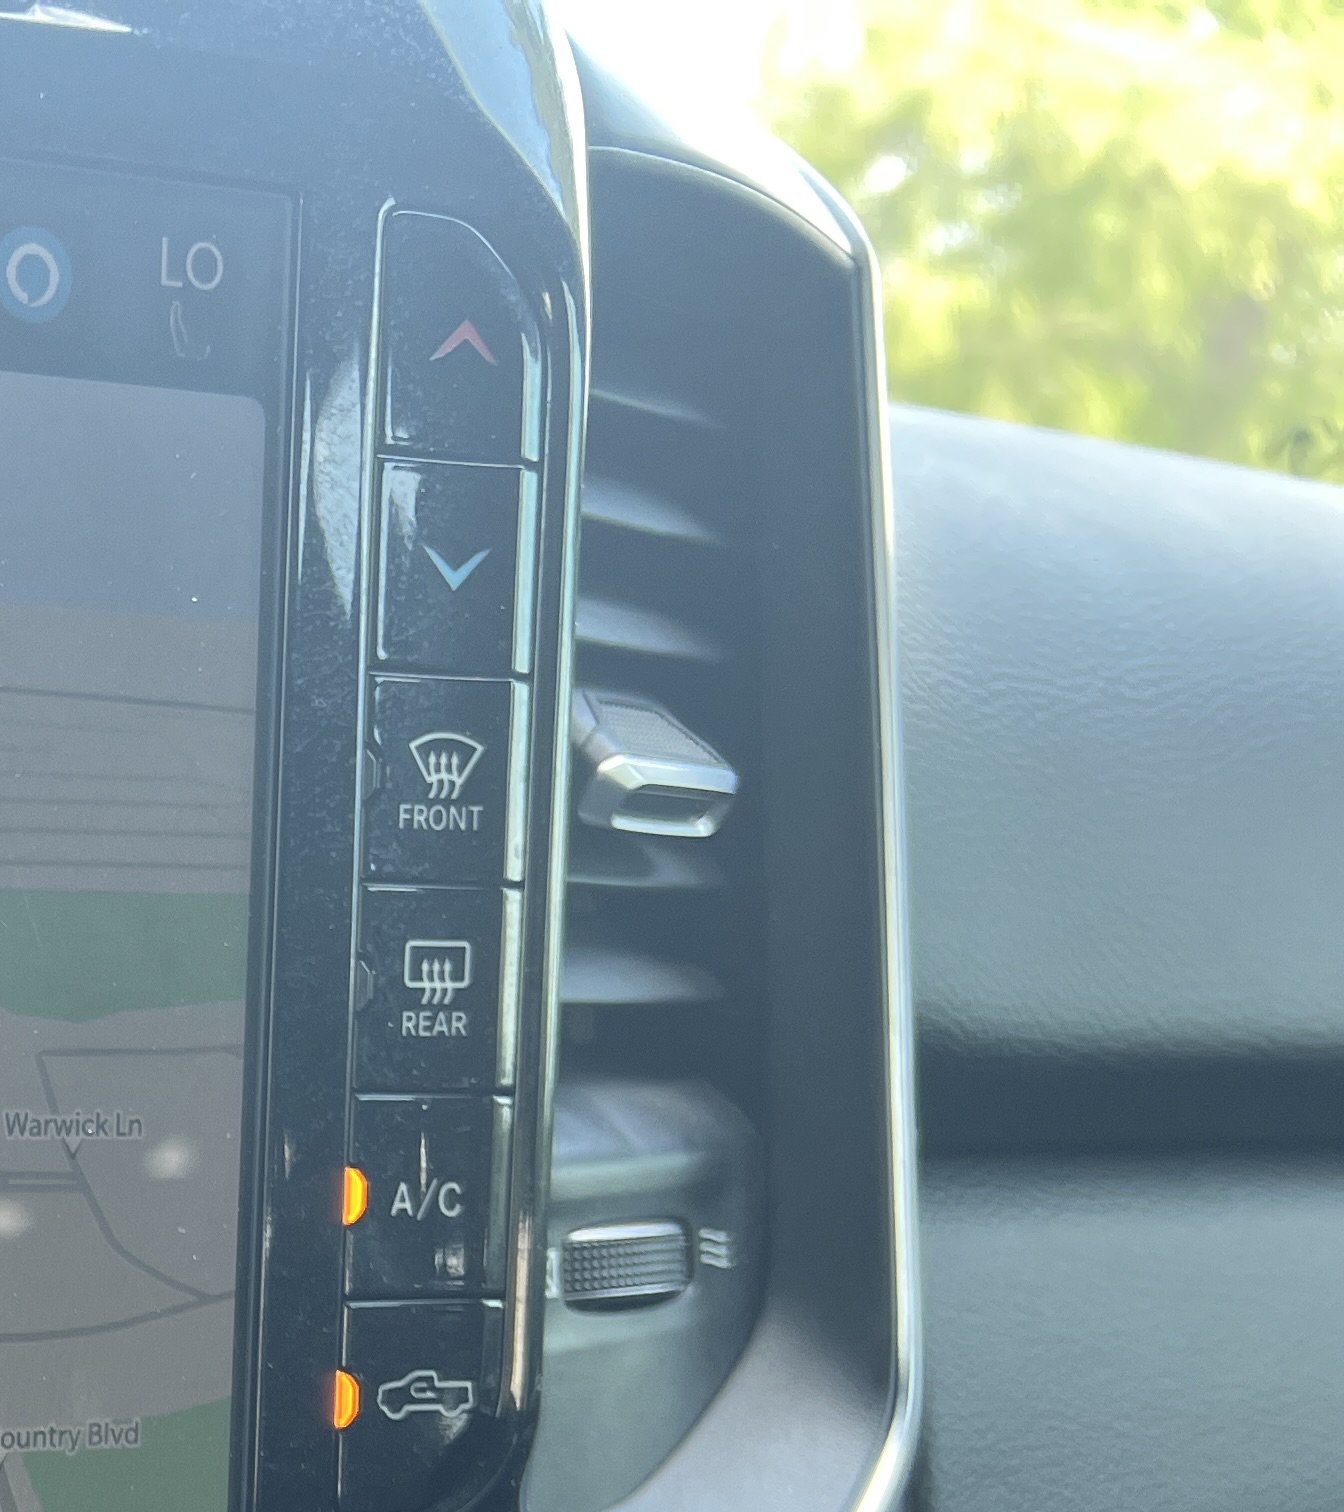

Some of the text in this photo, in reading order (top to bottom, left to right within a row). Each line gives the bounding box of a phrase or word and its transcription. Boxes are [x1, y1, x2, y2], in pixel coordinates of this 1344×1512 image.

[159, 235, 225, 292] LO
[397, 804, 484, 832] FRONT
[401, 1011, 468, 1038] REAR
[4, 1111, 143, 1138] Warwick Ln
[390, 1179, 464, 1221] A/C
[87, 1421, 141, 1447] Blvd
